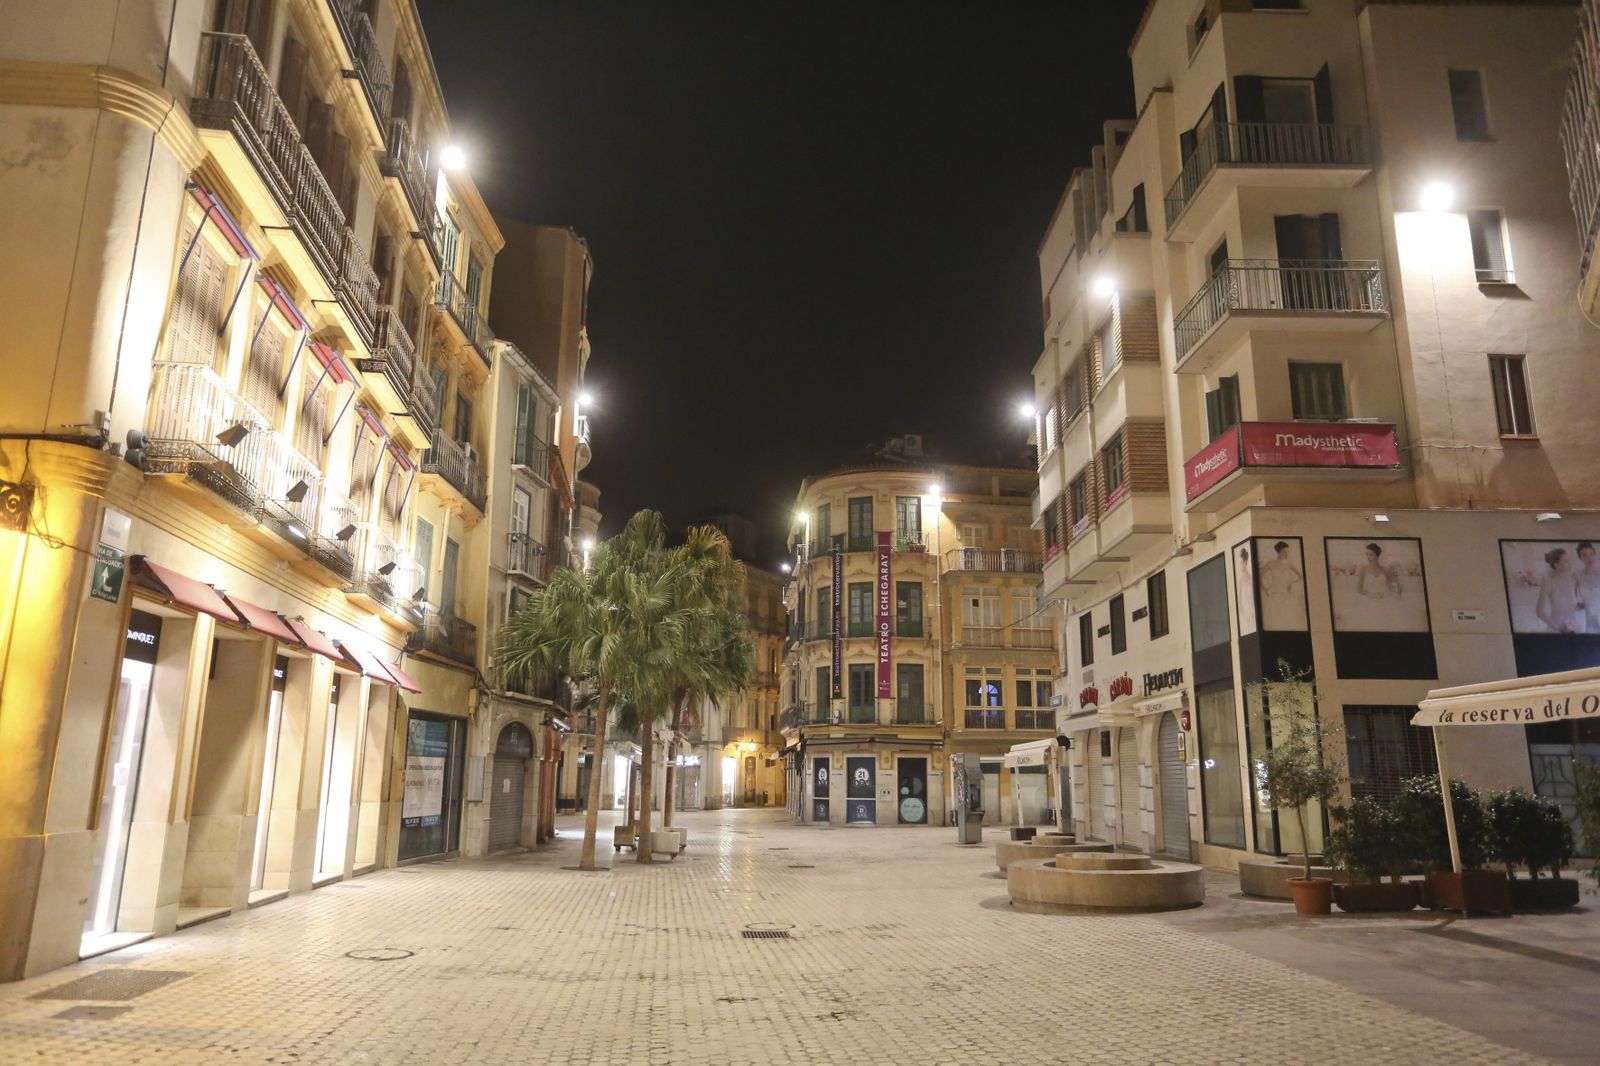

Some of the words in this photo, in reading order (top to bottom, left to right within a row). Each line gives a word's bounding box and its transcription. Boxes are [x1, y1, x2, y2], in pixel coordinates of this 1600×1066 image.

[1275, 434, 1361, 448] Madysthetic
[881, 554, 889, 617] ECHEGARAY
[881, 622, 889, 664] TEATRO
[1439, 709, 1453, 723] la
[1462, 706, 1534, 722] reserva
[1544, 697, 1570, 718] del
